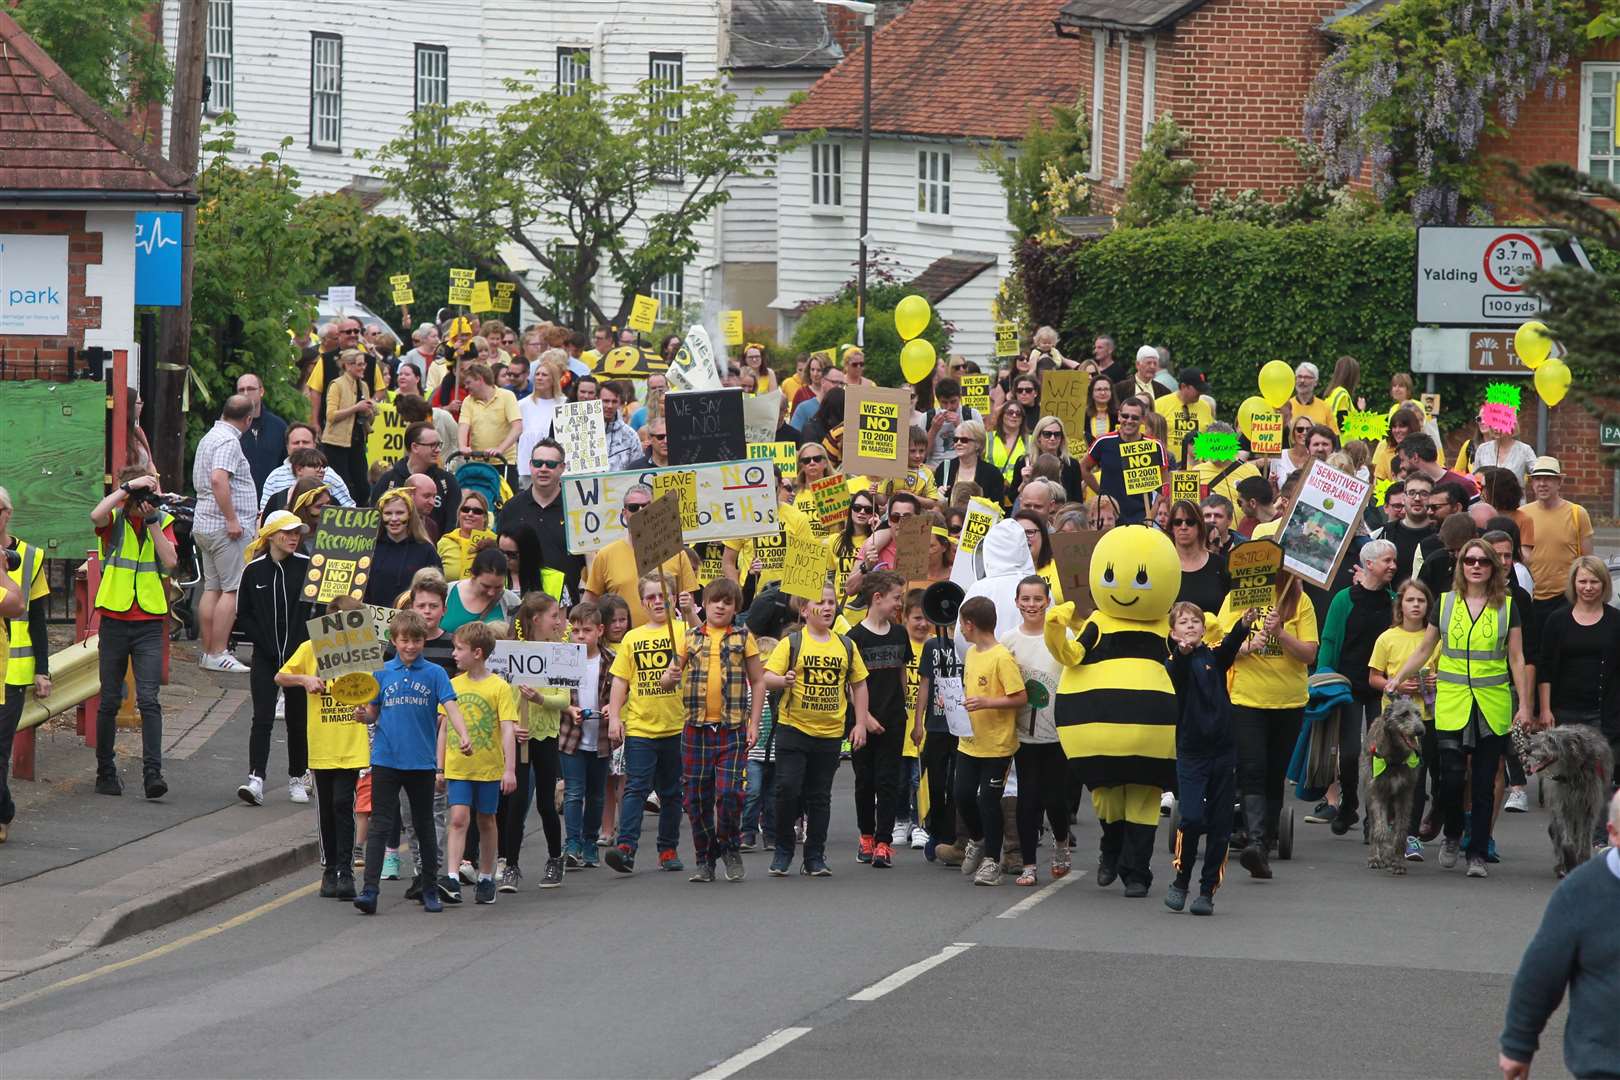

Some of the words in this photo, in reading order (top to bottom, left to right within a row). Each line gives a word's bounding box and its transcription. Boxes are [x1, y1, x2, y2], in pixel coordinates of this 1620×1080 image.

[1496, 248, 1518, 260] 3.7
[1424, 268, 1478, 283] Yalding
[454, 279, 470, 288] NO
[10, 286, 60, 306] park
[1490, 301, 1512, 312] 100
[1515, 301, 1535, 312] yds
[1000, 332, 1014, 340] NO
[967, 386, 984, 396] NO
[1048, 380, 1083, 398] WE
[672, 398, 692, 416] WE
[700, 397, 722, 414] SAY
[864, 404, 878, 414] WE
[878, 406, 895, 416] SAY
[1045, 400, 1082, 417] SAY
[692, 415, 720, 434] NO!
[866, 416, 890, 430] NO
[1178, 420, 1196, 430] NO
[1252, 423, 1282, 431] PILLAGE
[383, 434, 403, 450] 20
[862, 432, 872, 440] TO
[874, 432, 894, 442] 2000
[750, 445, 776, 458] FIRM
[784, 444, 795, 456] IN
[868, 446, 894, 454] MARDEN
[1122, 445, 1137, 454] WE
[1138, 442, 1153, 452] SAY
[1252, 442, 1280, 452] VILLAGE
[1128, 454, 1152, 468] NO
[720, 465, 765, 486] NO
[1126, 470, 1136, 478] TO
[1138, 468, 1158, 477] 2000
[655, 473, 692, 488] LEAVE
[811, 475, 843, 492] PLANET
[1136, 480, 1160, 488] MARDEN
[1178, 482, 1194, 491] NO
[575, 476, 614, 506] WE
[798, 501, 810, 510] WE
[322, 508, 380, 528] PLEASE
[698, 502, 736, 526] ORE
[970, 512, 979, 520] WE
[980, 514, 992, 524] SAY
[568, 510, 600, 534] TO
[970, 522, 986, 534] NO
[758, 536, 782, 548] NO
[788, 537, 826, 558] DORMICE
[766, 548, 786, 557] 2000
[795, 554, 820, 570] NOT
[328, 570, 348, 582] NO
[1236, 568, 1252, 576] WE
[1254, 564, 1272, 574] SAY
[784, 564, 825, 590] DIGGERS
[1240, 575, 1267, 588] NO
[1234, 590, 1246, 598] TO
[1248, 586, 1272, 595] 2000
[322, 611, 364, 634] NO
[1482, 613, 1493, 638] NO
[634, 640, 650, 650] WE
[652, 638, 671, 650] SAY
[318, 646, 380, 670] HOUSES
[508, 654, 548, 674] NO!
[638, 652, 668, 668] NO
[803, 656, 820, 667] WE
[823, 656, 842, 667] SAY
[638, 672, 646, 682] TO
[648, 670, 666, 680] 20
[808, 669, 837, 684] NO
[384, 682, 398, 696] EST
[410, 681, 431, 697] 1892
[804, 686, 816, 696] TO
[818, 687, 839, 697] 2000
[321, 697, 332, 707] TO
